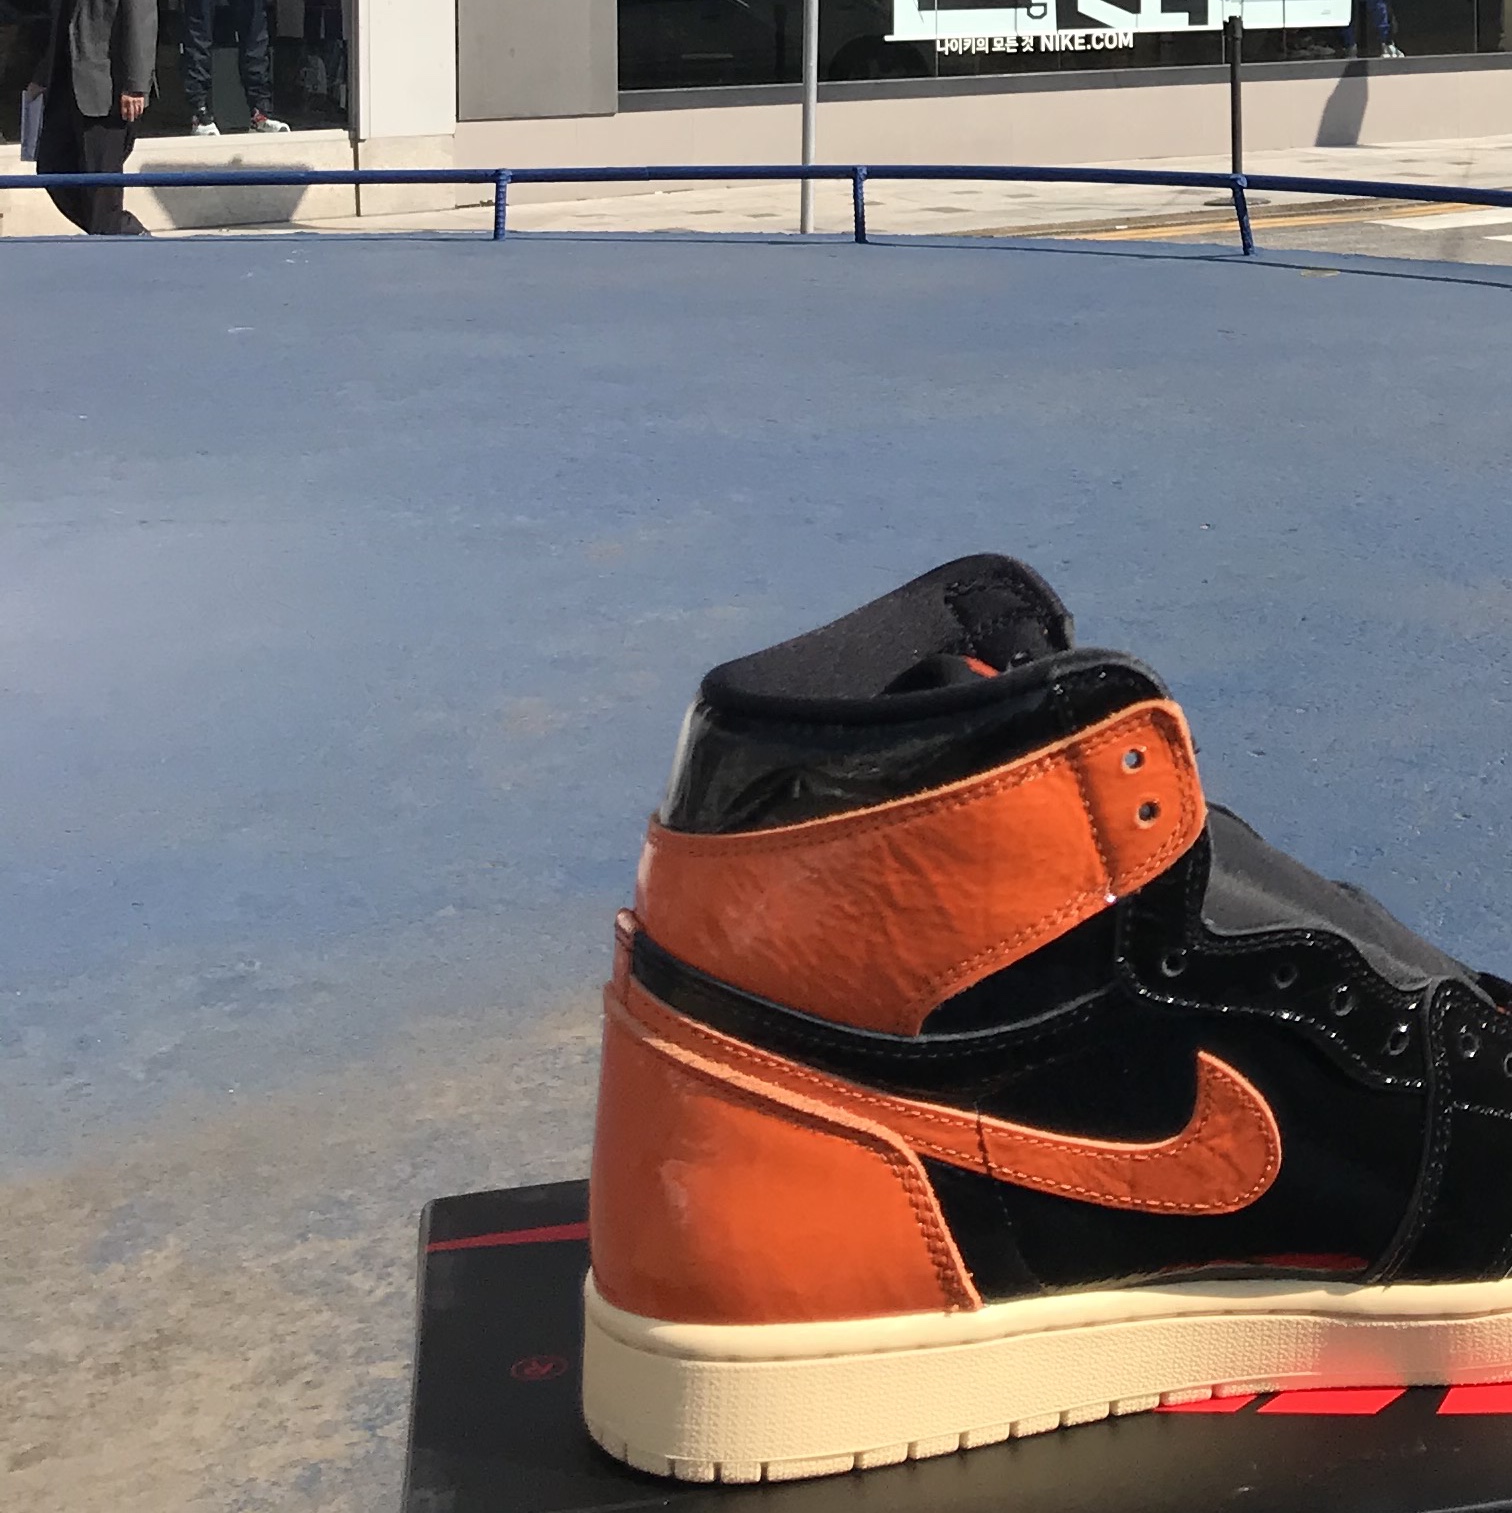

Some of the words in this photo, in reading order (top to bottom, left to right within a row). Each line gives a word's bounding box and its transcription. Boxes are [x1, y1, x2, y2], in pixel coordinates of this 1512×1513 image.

[936, 38, 990, 56] 나이키의
[992, 37, 1018, 53] 모든
[1021, 35, 1034, 52] 것
[1041, 33, 1134, 52] NIKE.COM
